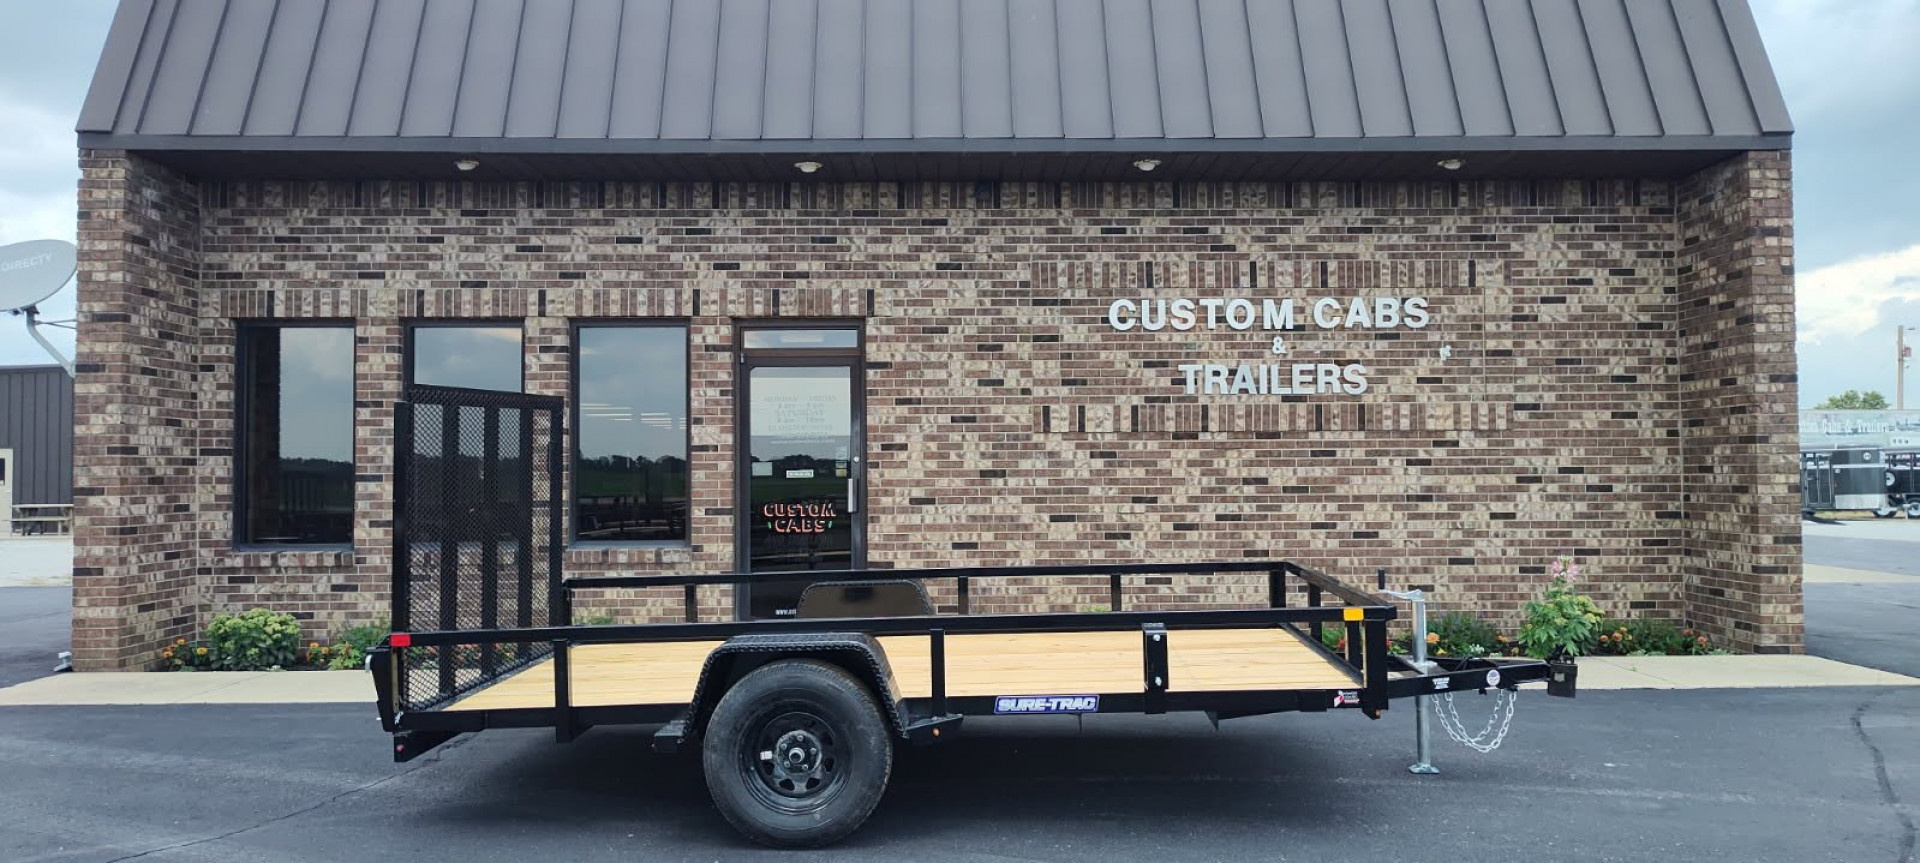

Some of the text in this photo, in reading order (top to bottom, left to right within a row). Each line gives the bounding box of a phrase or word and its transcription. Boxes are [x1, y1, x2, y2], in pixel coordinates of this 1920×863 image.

[1108, 297, 1430, 331] CUSTOM CABS
[1272, 336, 1287, 355] &
[1178, 363, 1368, 396] TRAILERS
[764, 503, 836, 517] CUSTOM
[774, 518, 826, 533] CABS
[998, 697, 1096, 711] SURE-TRAC
